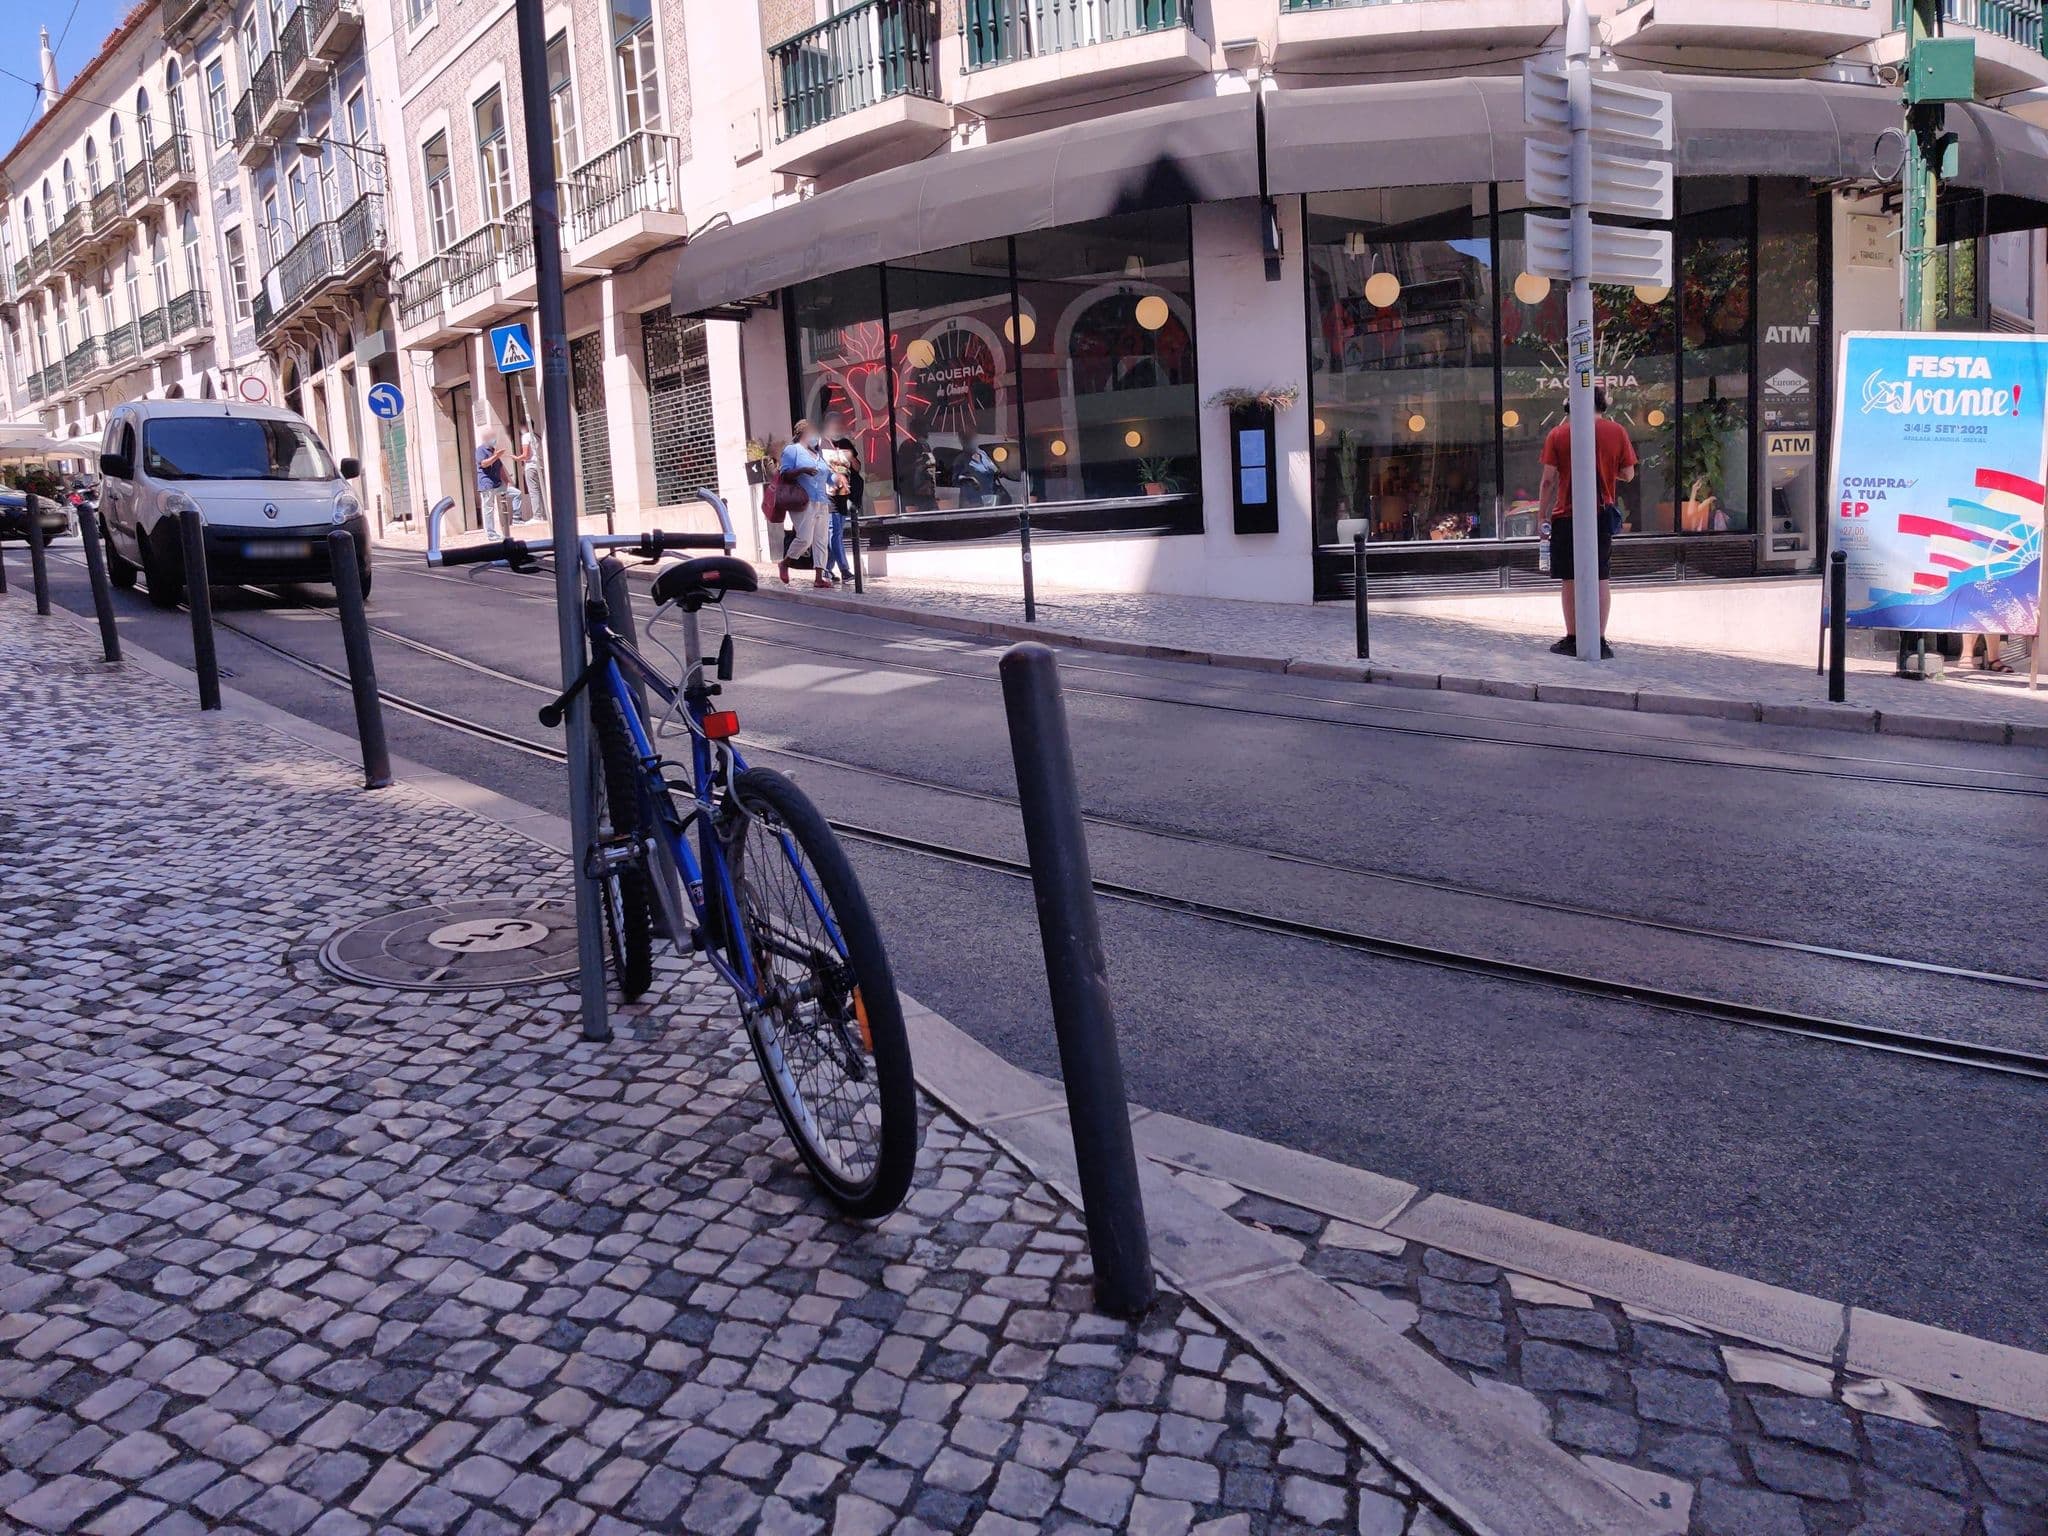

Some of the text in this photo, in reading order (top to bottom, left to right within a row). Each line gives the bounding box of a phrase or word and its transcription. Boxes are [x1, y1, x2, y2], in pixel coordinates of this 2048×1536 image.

[1765, 326, 1810, 343] ATM
[918, 364, 985, 384] TAQUERIA
[1907, 355, 1992, 379] FESTA
[1536, 375, 1639, 389] TAERIA
[1771, 438, 1810, 452] ATM
[1842, 477, 1907, 489] COMPRA
[1841, 489, 1887, 500] A TUA
[1840, 502, 1870, 517] EP
